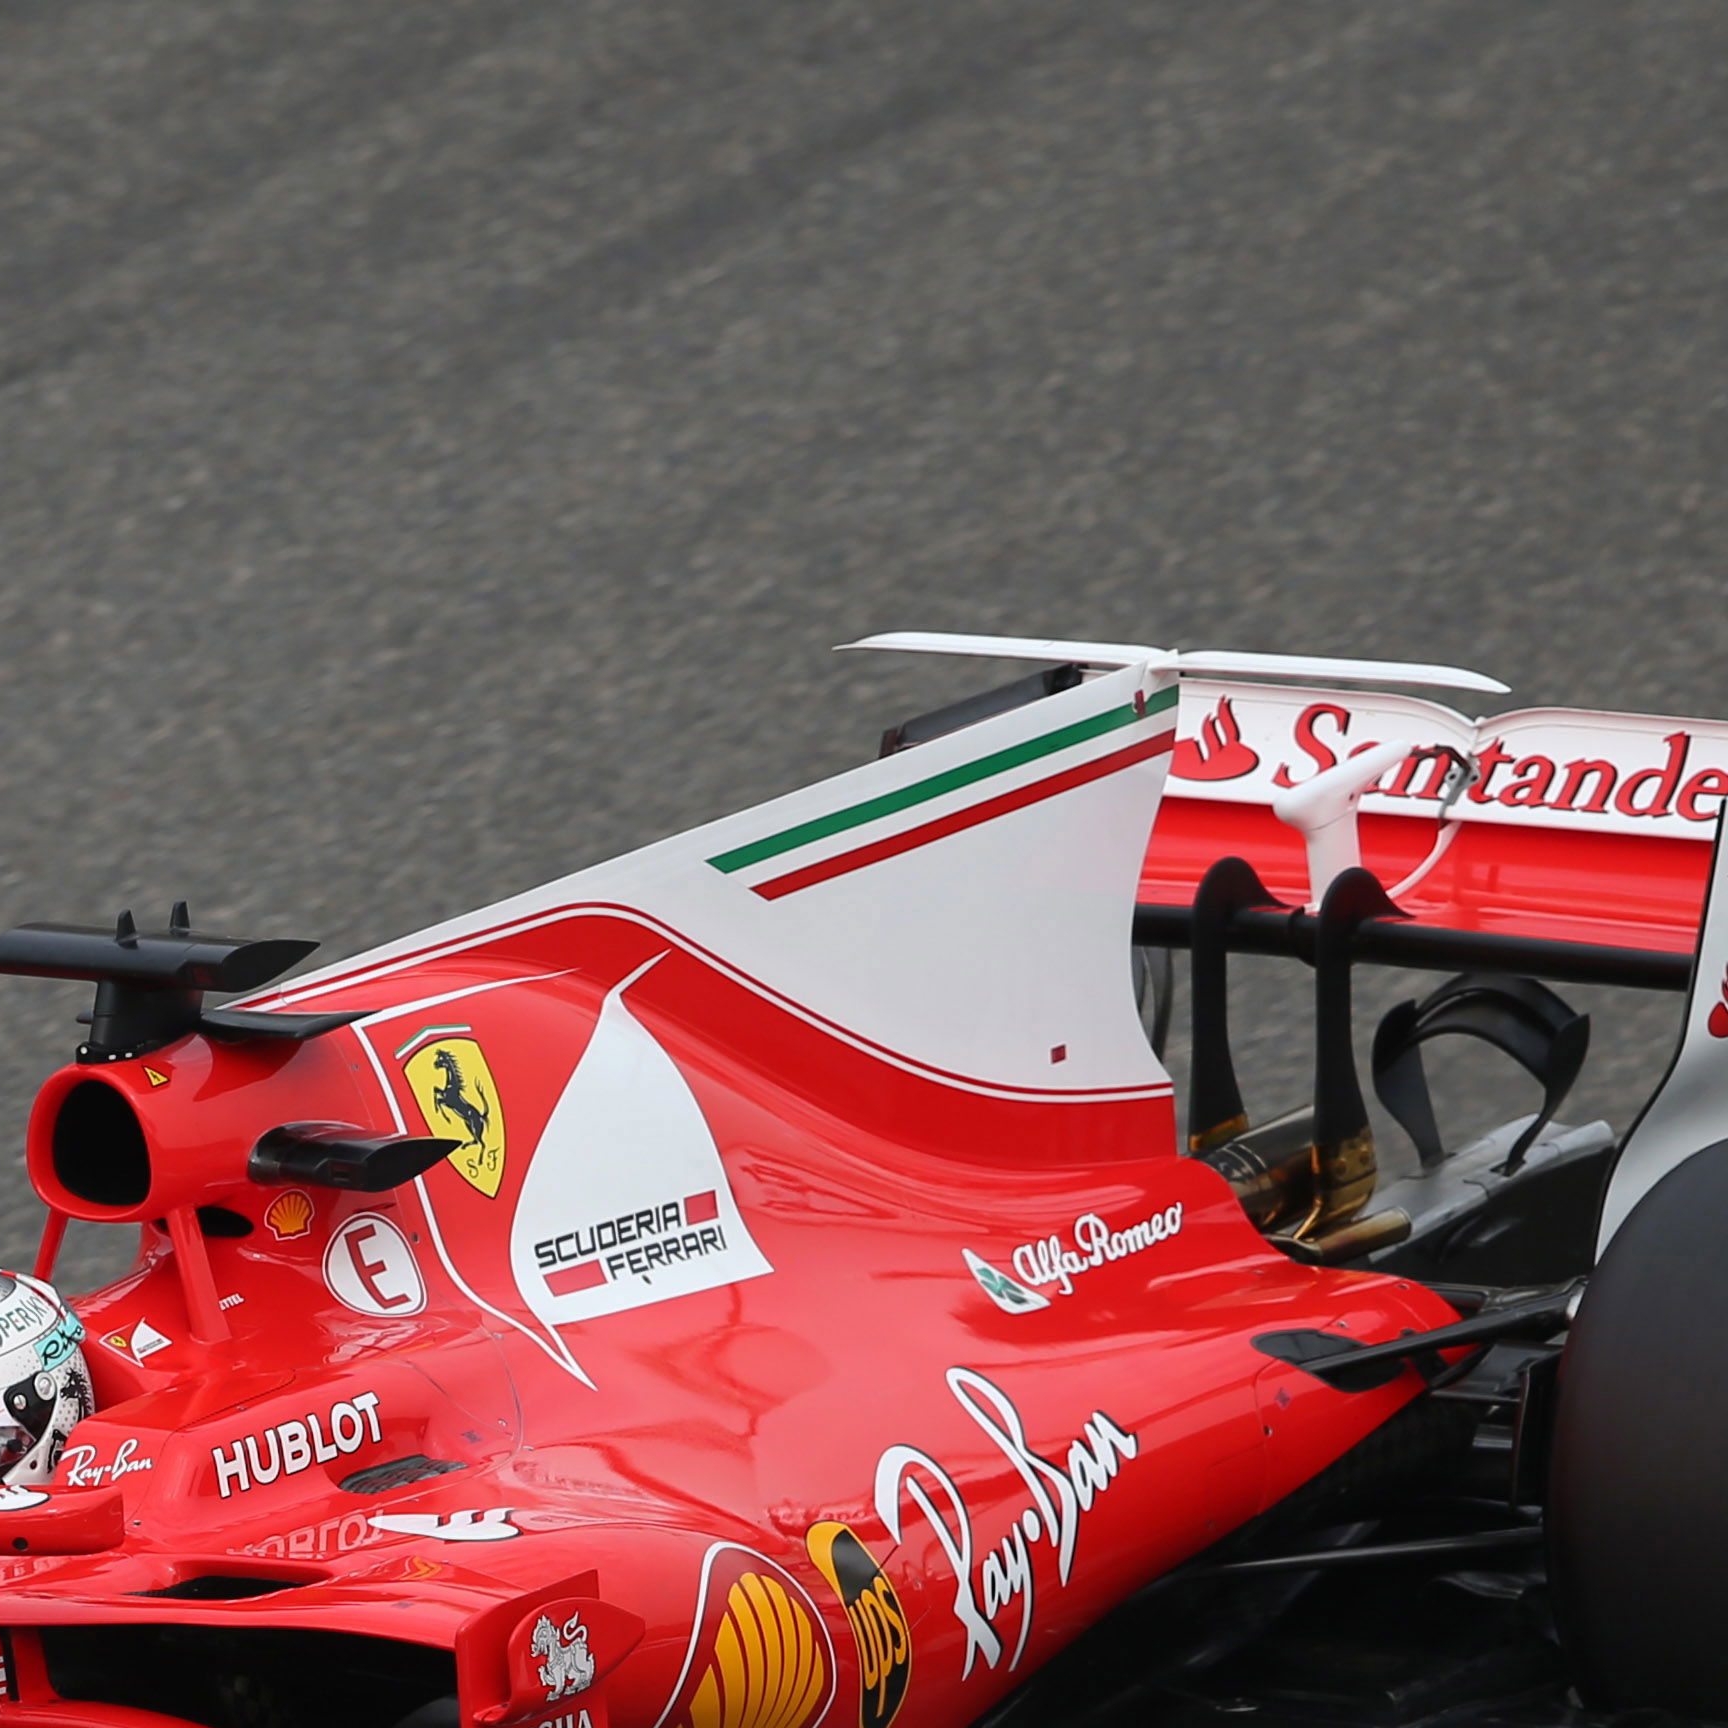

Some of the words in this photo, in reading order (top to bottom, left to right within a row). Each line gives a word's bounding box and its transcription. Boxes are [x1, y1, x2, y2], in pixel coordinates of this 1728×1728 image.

[1272, 702, 1728, 822] Sntande
[534, 1202, 682, 1269] SCUDERIA
[606, 1225, 727, 1280] FERRARI
[1012, 1235, 1089, 1295] Alfa
[1074, 1213, 1183, 1266] Romeo
[59, 1438, 154, 1487] Ray-Ban
[212, 1391, 382, 1498] HUBLOT
[872, 1365, 1139, 1683] Ray-Ban
